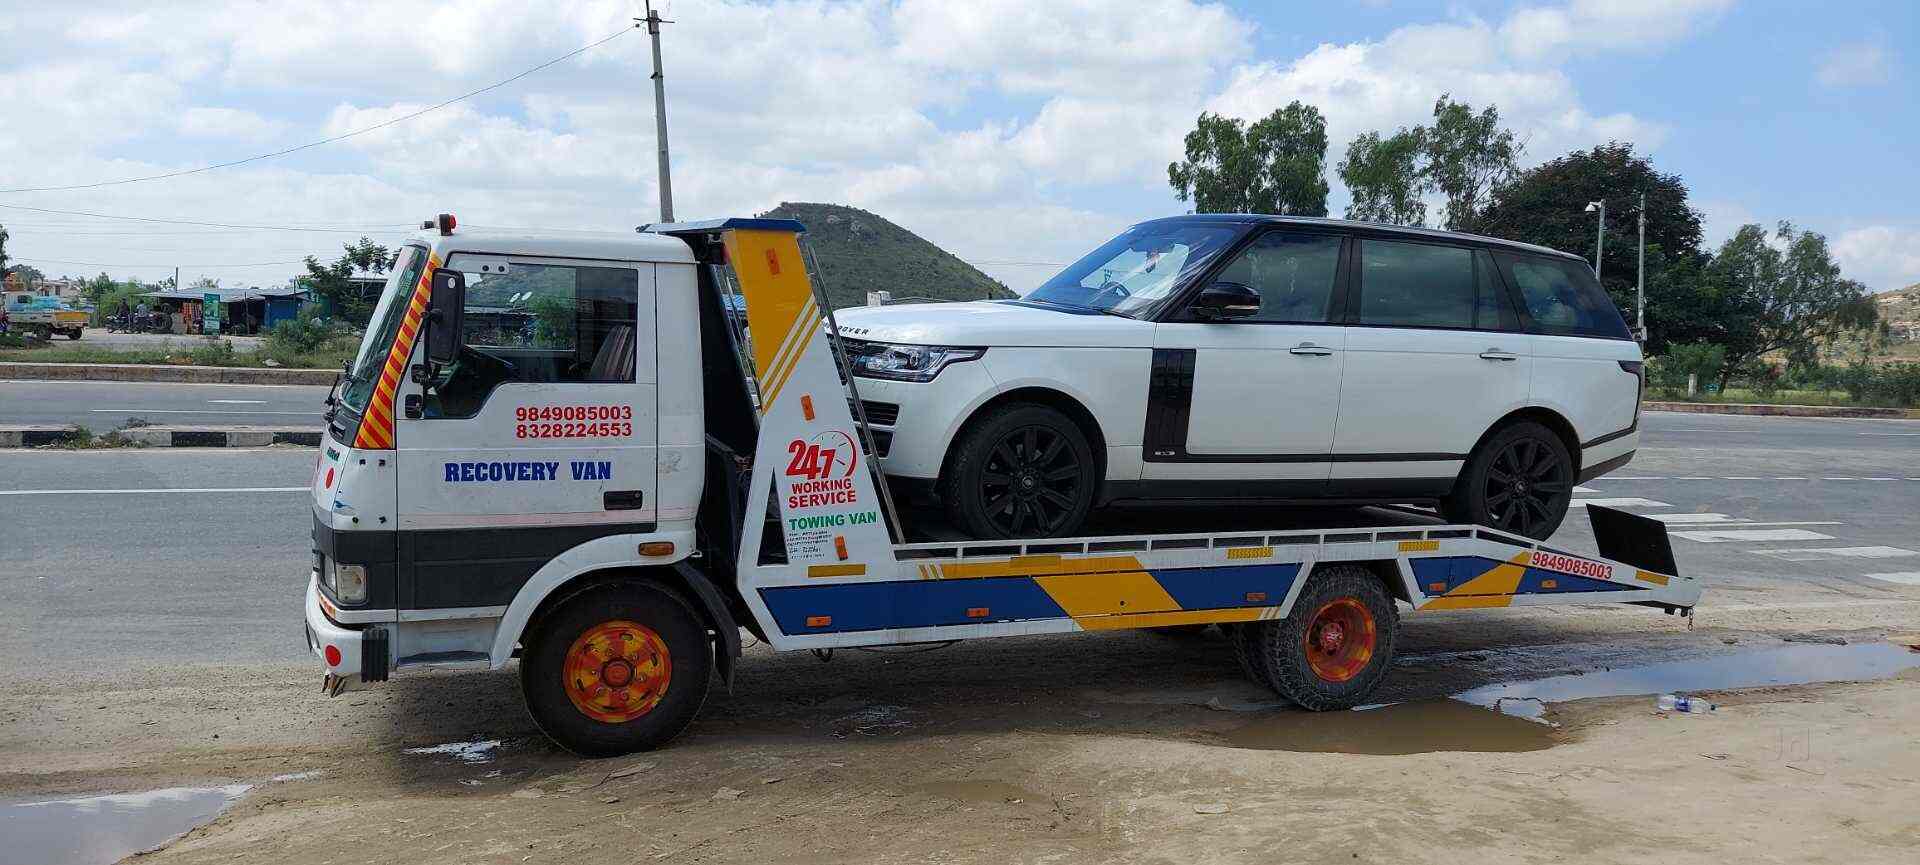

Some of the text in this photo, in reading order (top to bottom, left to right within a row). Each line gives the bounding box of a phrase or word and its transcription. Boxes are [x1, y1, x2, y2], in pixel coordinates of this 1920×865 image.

[515, 405, 632, 421] 9849085003
[515, 422, 632, 438] 8328224553
[444, 461, 612, 482] RECOVERY VAN
[791, 478, 852, 494] WORKING
[788, 490, 857, 509] SERVICE
[788, 511, 877, 531] TOWING VAN
[1532, 551, 1613, 579] 9849085003
